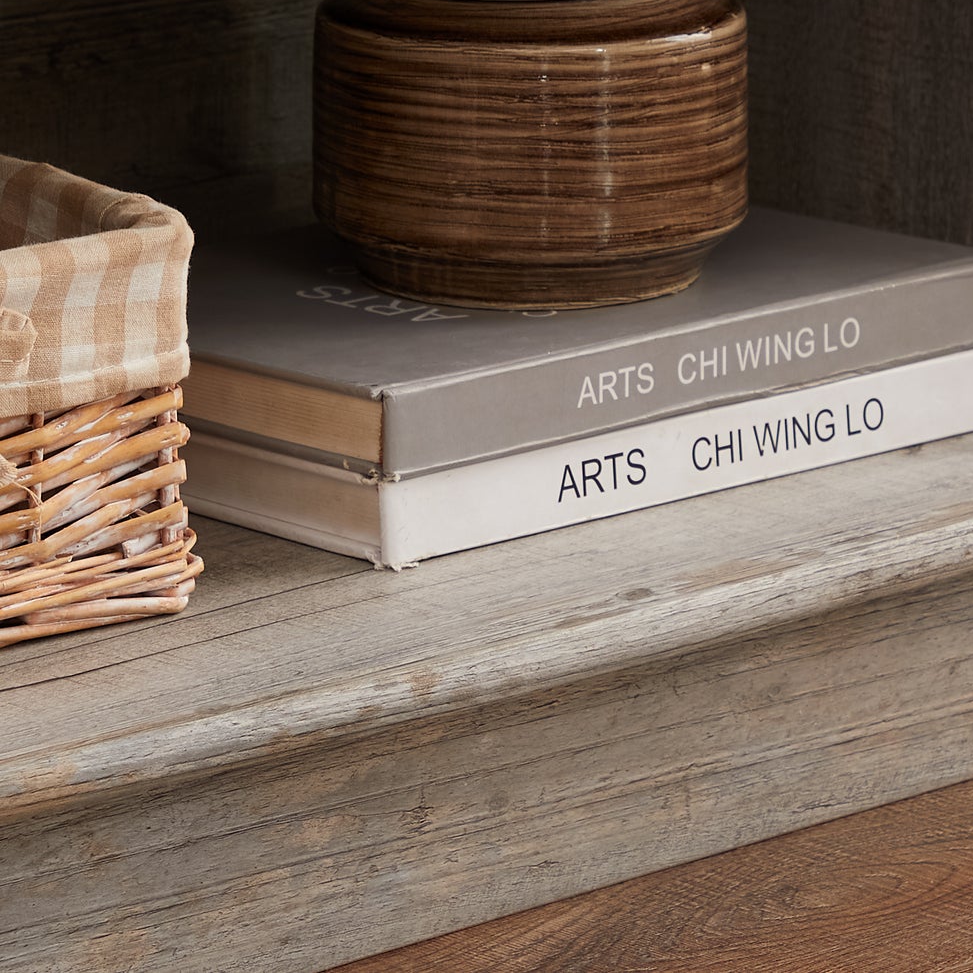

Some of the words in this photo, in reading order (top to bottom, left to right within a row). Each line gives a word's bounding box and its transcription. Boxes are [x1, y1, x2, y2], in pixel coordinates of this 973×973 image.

[577, 362, 655, 408] ARTS
[677, 345, 728, 385] CHI
[735, 327, 815, 371] WING
[822, 317, 862, 354] LO
[557, 447, 648, 504] ARTS
[691, 428, 744, 471] CHI
[753, 408, 836, 457] WING
[845, 397, 885, 437] LO
